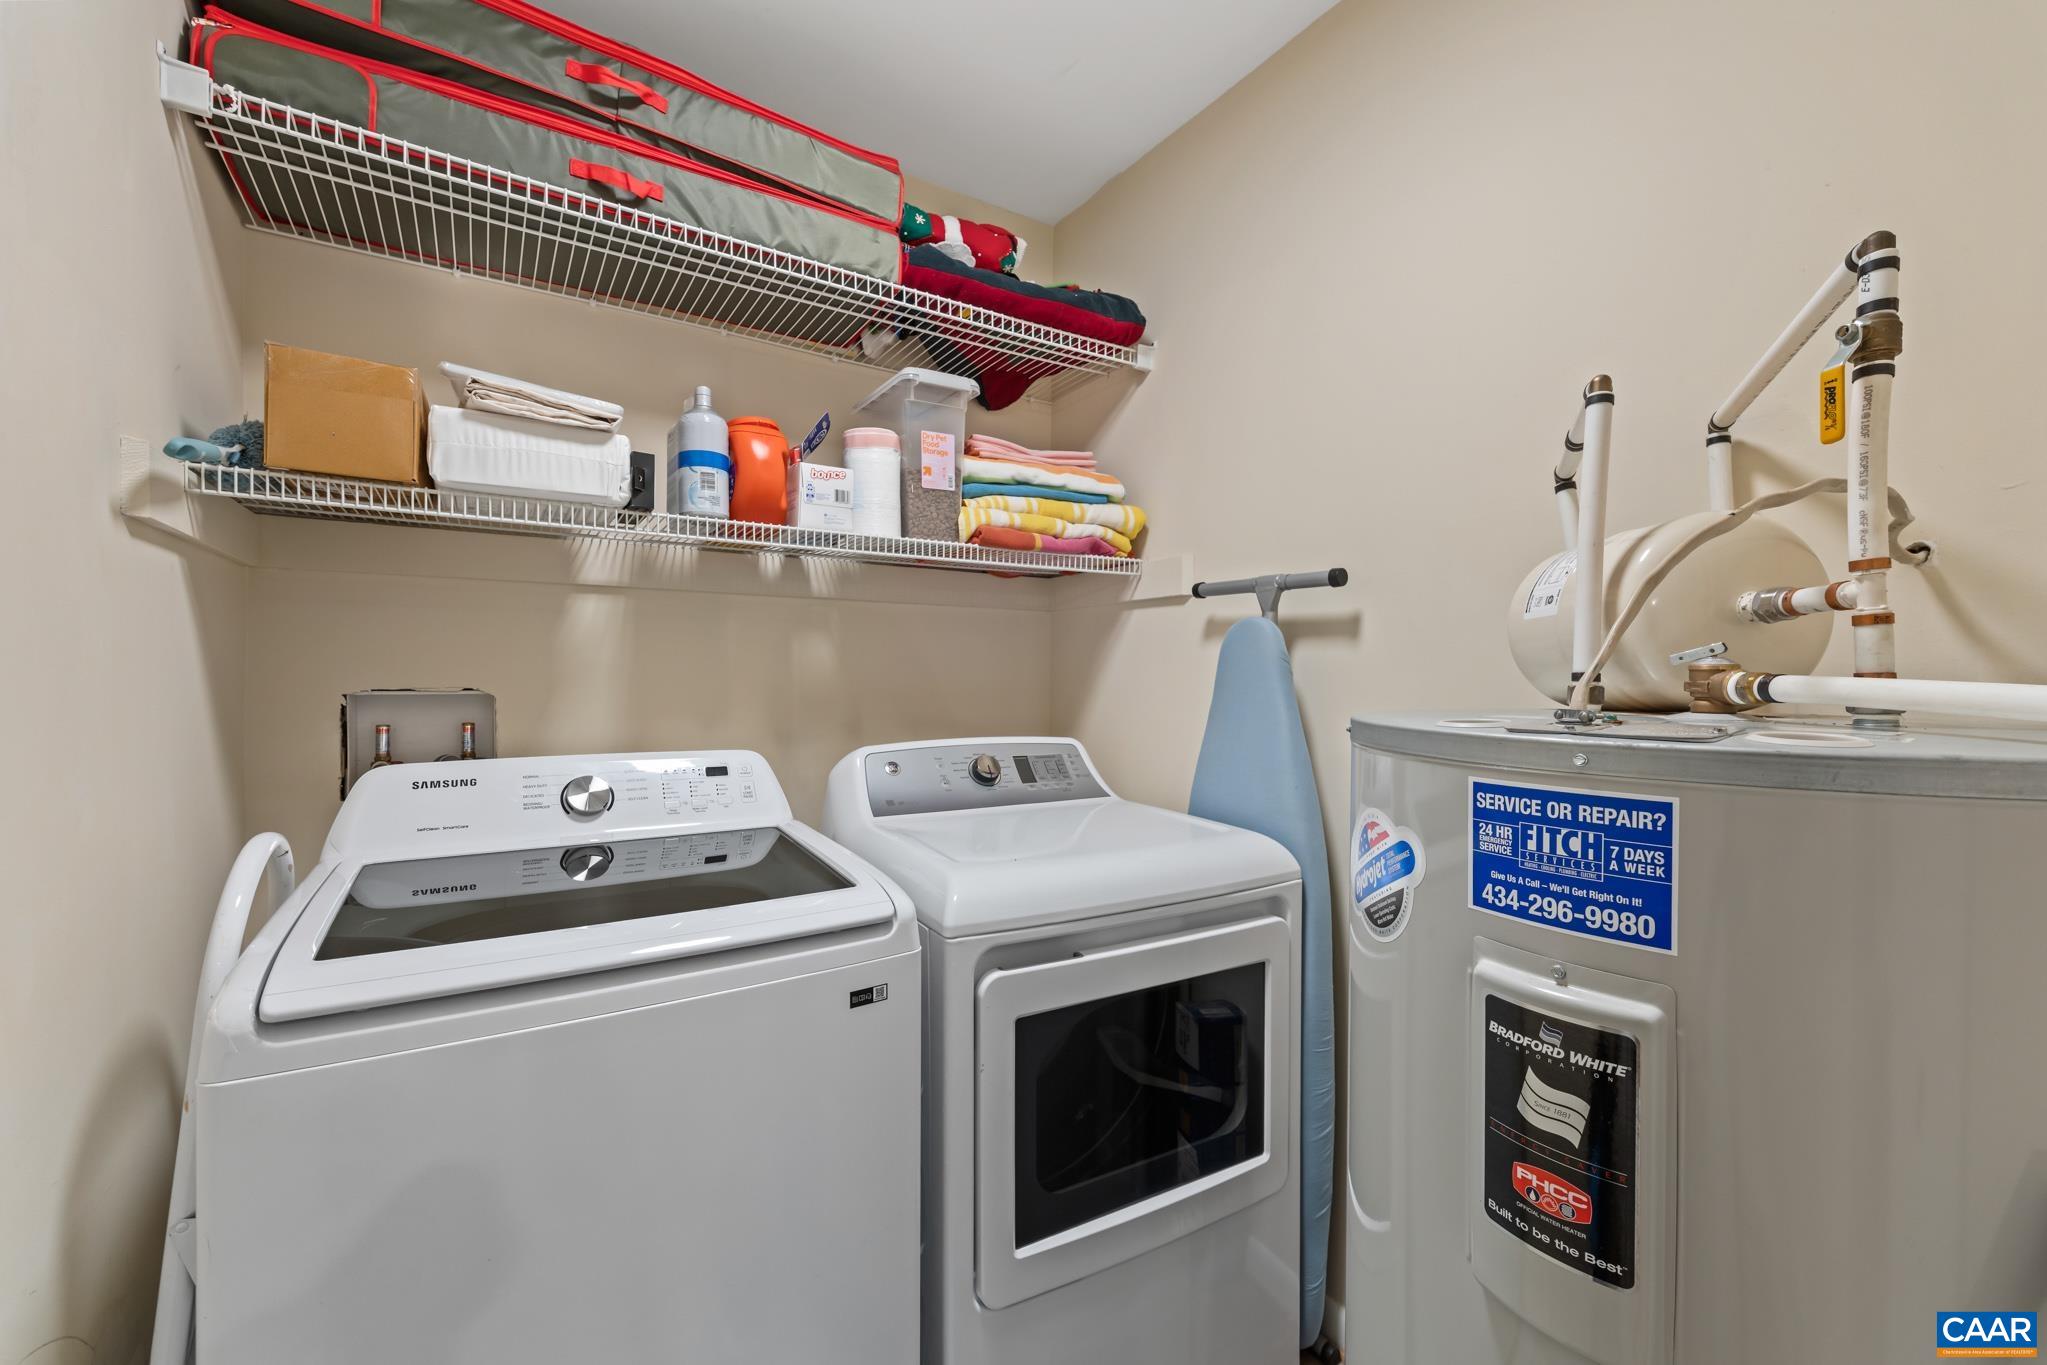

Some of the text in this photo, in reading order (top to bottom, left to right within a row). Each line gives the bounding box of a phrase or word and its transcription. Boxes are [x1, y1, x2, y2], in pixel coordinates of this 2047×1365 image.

[922, 431, 948, 443] Dry Pet
[922, 439, 940, 449] Food
[922, 446, 949, 458] Storage
[810, 468, 846, 481] bounce
[412, 778, 478, 790] SAMSUNG
[1476, 791, 1667, 832] SERVICE OR REPAIR?
[1479, 822, 1513, 840] 24 HR
[1479, 835, 1513, 847] EMERGENCY
[1479, 841, 1513, 856] SERVICE
[1526, 824, 1595, 861] FITCH
[1526, 852, 1596, 872] SERVICES
[1610, 846, 1665, 865] 7 DAYS
[1609, 860, 1666, 878] A WEEK
[1490, 870, 1506, 881] Give
[1506, 873, 1517, 884] Us
[1517, 875, 1524, 885] A
[1525, 878, 1540, 889] Call
[1549, 882, 1570, 895] We'll
[1571, 887, 1587, 898] Get
[1589, 889, 1614, 904] Right
[1616, 895, 1629, 906] On
[1632, 898, 1642, 908] It!
[1481, 883, 1656, 940] 434-296-9980
[1488, 1020, 1565, 1059] BRADFORD
[1496, 1037, 1614, 1083] CORPORATION
[1553, 1107, 1571, 1120] 1881
[1564, 1157, 1627, 1184] SAVER
[1516, 1166, 1588, 1209] PHCC
[1488, 1198, 1513, 1223] Built
[1515, 1217, 1529, 1232] to
[1532, 1226, 1550, 1243] be
[1554, 1238, 1580, 1258] the
[1516, 1201, 1587, 1239] OFFICIAL WATER HEATER
